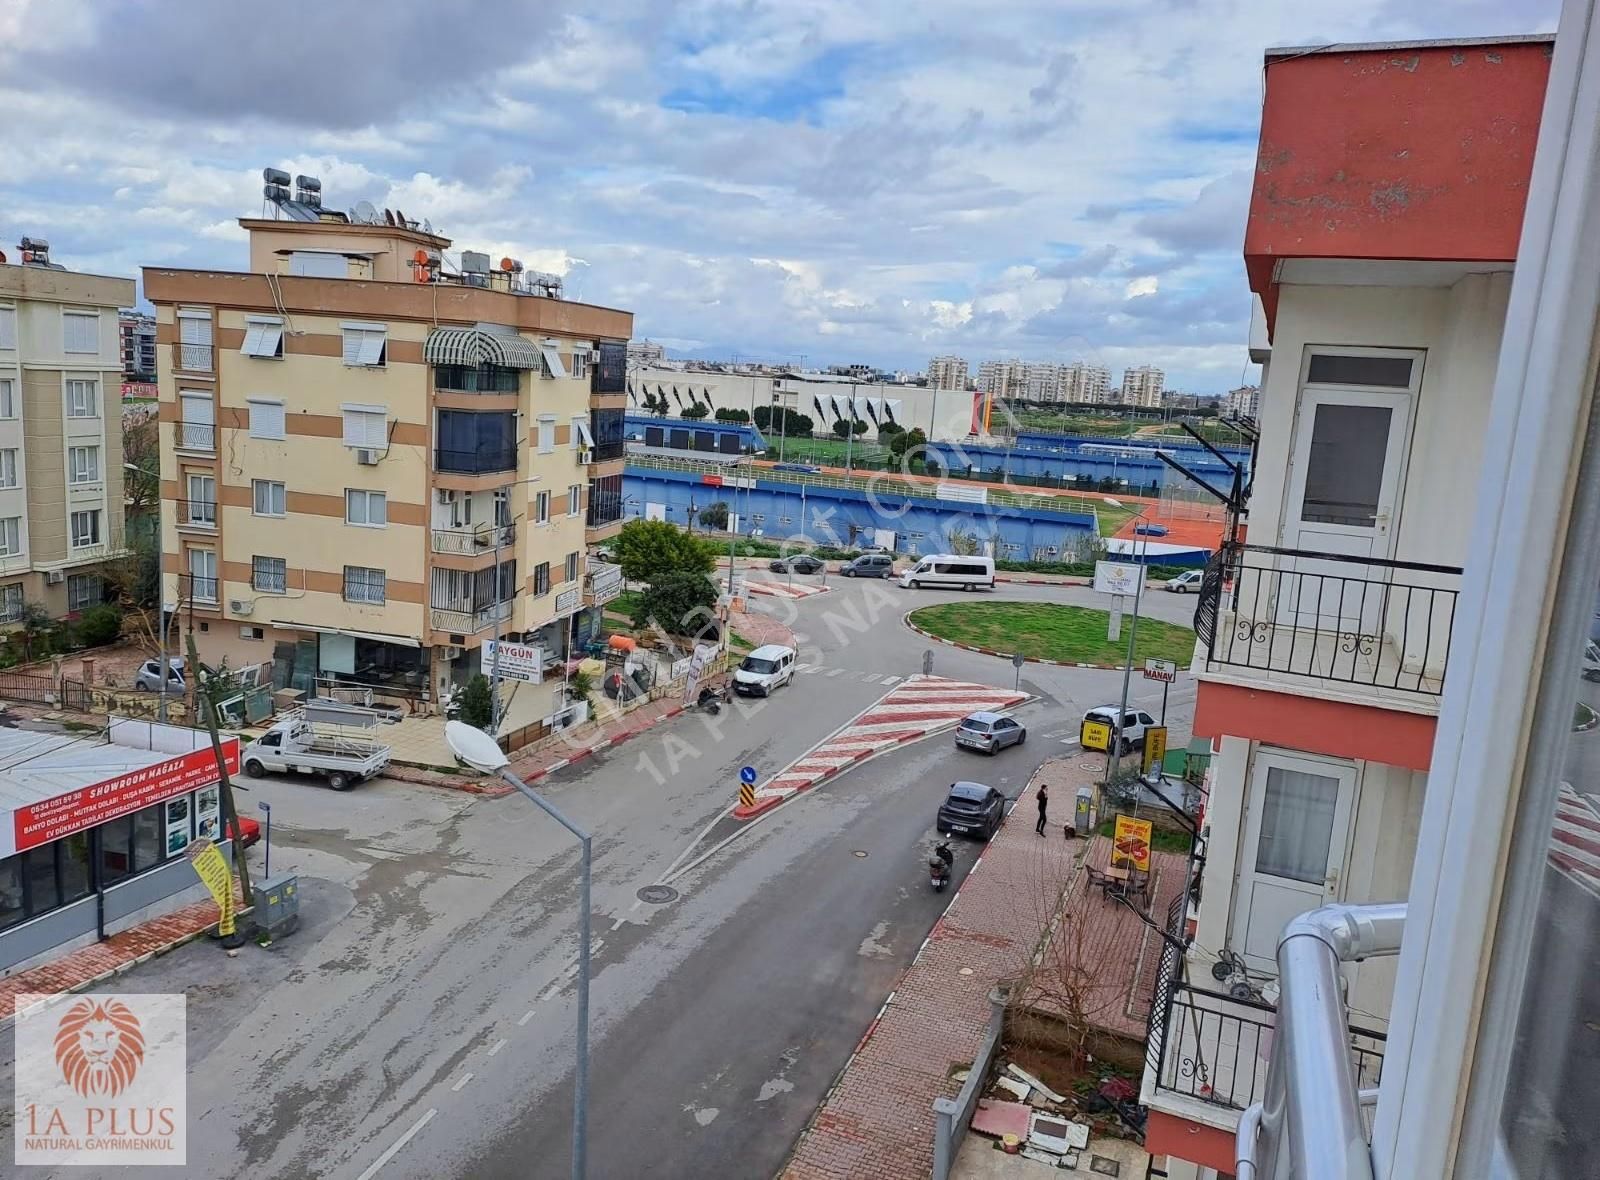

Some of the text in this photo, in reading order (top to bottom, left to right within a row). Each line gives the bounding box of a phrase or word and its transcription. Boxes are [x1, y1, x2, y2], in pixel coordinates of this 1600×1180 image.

[498, 646, 533, 659] AYGÜN
[1144, 669, 1173, 681] MANAV
[89, 759, 185, 799] SHOWROOM MAĞAZA
[23, 822, 46, 834] BANYO
[46, 815, 69, 827] DOLABI
[73, 806, 97, 818] MUTFAK
[97, 798, 119, 809] DOLABI
[30, 803, 49, 815] 0534
[46, 829, 54, 839] EV
[55, 821, 81, 834] DÜKKAN
